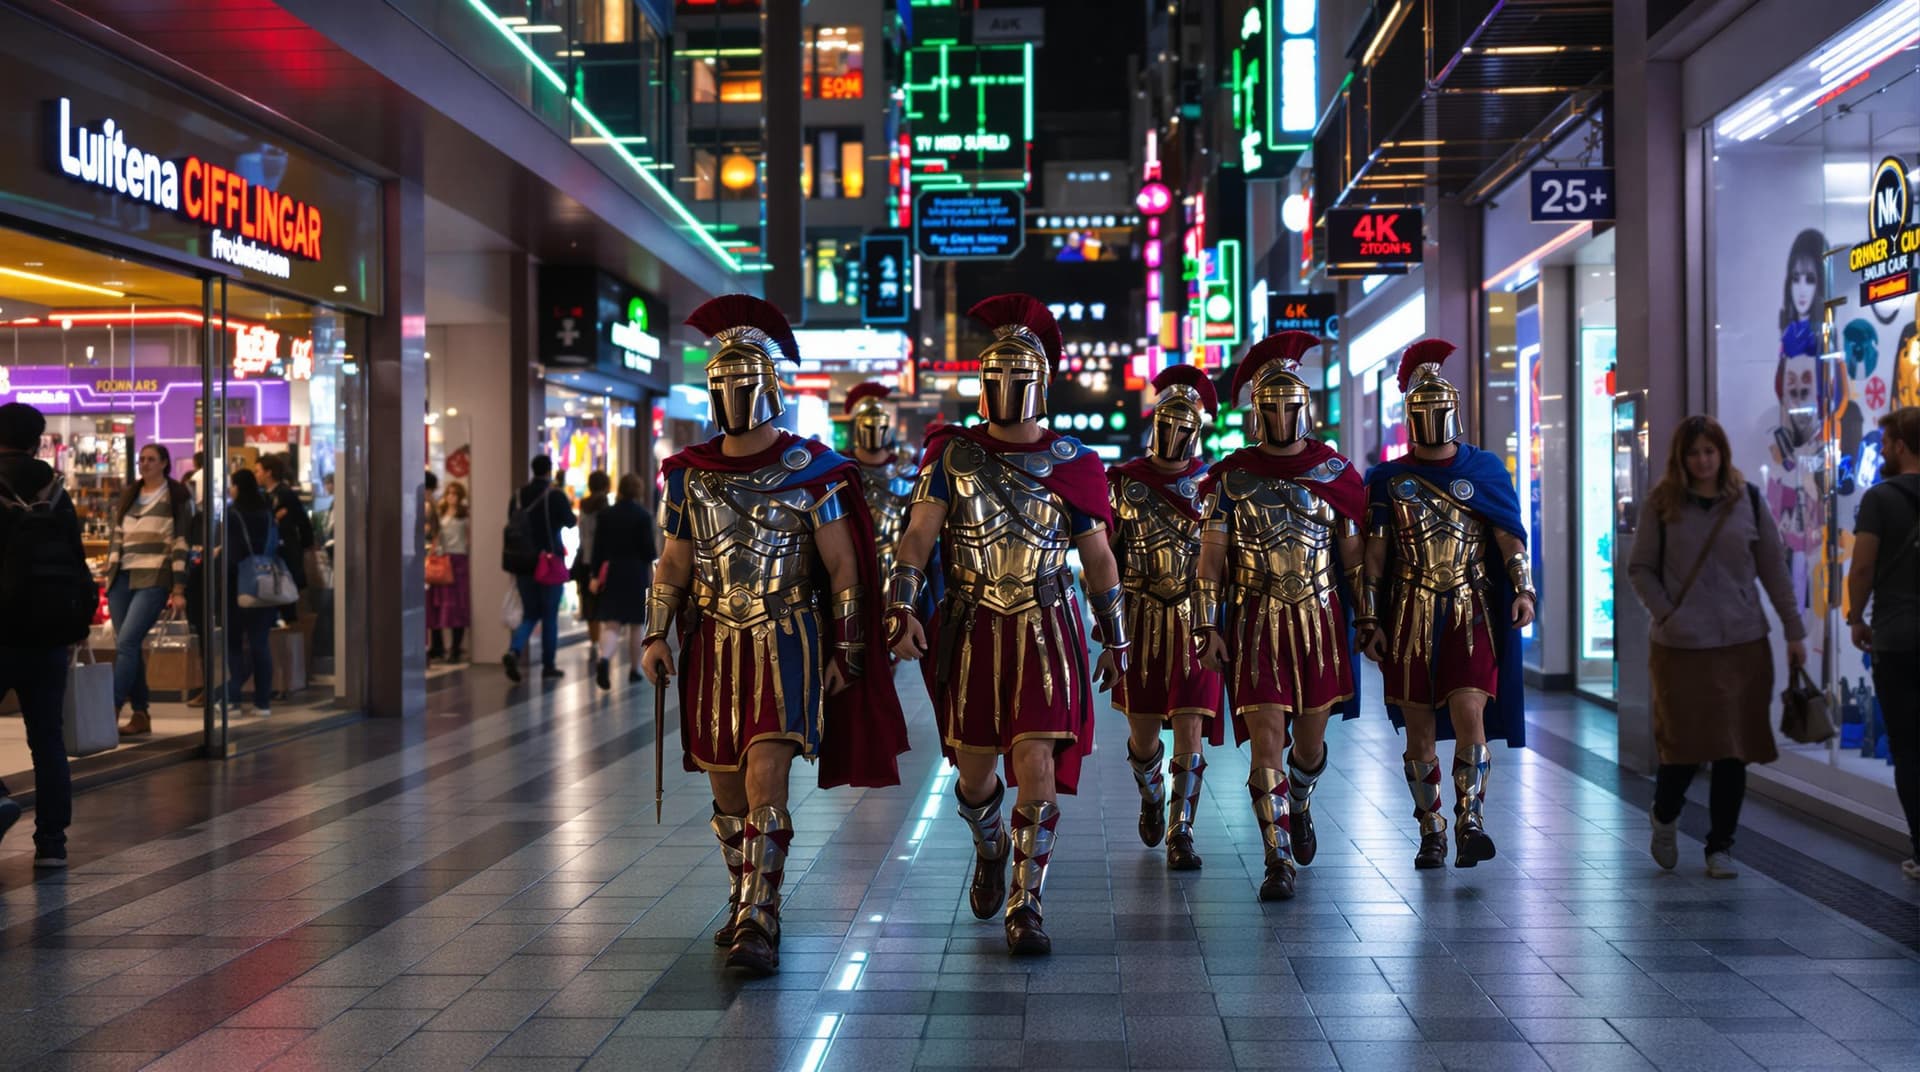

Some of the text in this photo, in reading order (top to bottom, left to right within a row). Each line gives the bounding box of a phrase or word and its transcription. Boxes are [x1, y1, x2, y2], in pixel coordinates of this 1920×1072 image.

[183, 155, 322, 262] CIFFLINGAR
[1541, 179, 1607, 213] 25+
[1352, 213, 1400, 243] 4K
